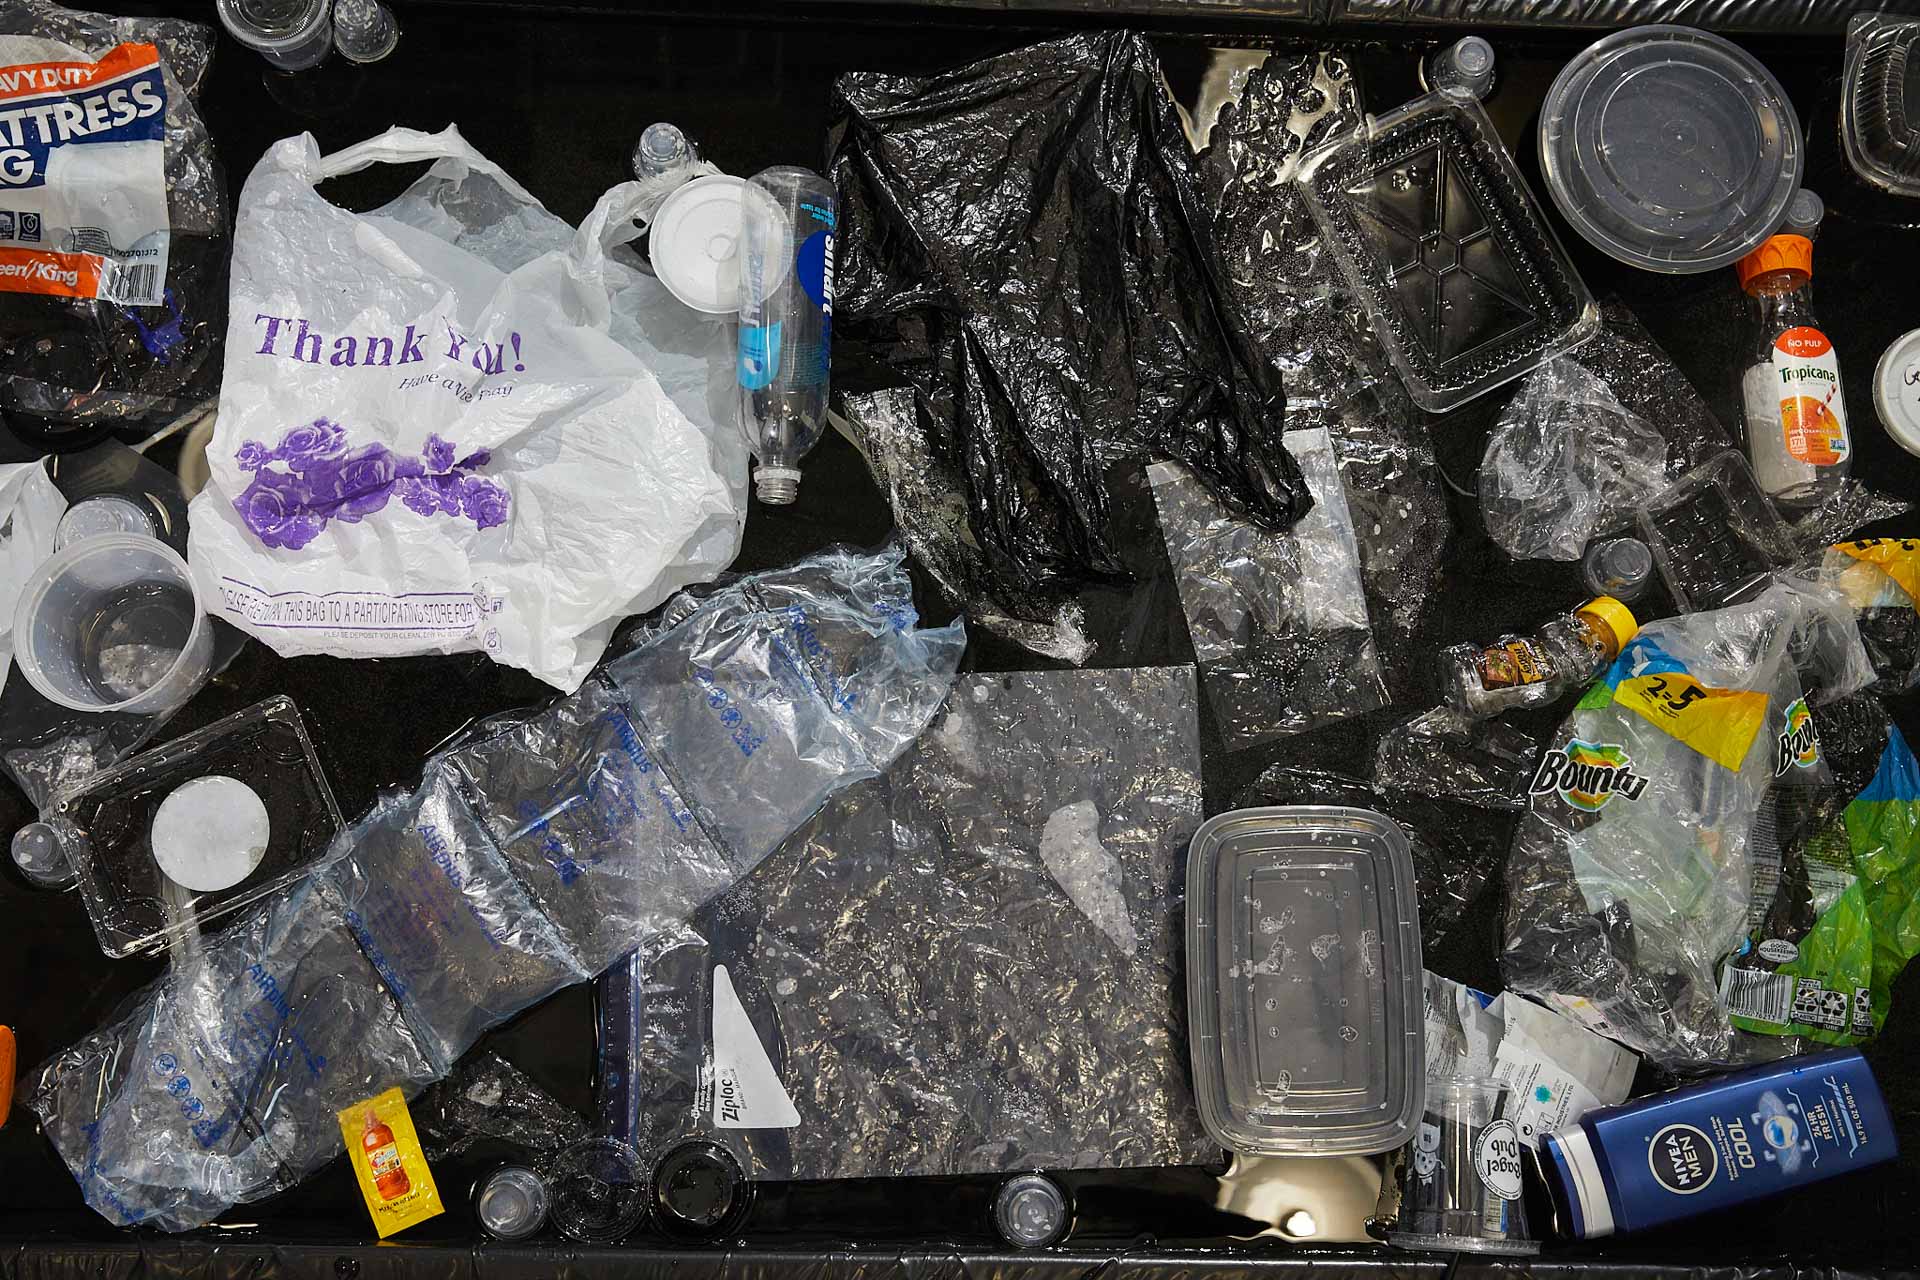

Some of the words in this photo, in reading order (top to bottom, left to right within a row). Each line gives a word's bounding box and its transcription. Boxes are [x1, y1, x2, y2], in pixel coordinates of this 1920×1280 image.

[254, 313, 429, 367] Thank
[1787, 339, 1802, 348] NO
[1804, 339, 1822, 348] PULP
[399, 371, 440, 390] Have
[1779, 364, 1836, 384] Tropicana
[285, 600, 304, 622] THIS
[306, 600, 327, 622] BAG
[328, 600, 342, 622] TO
[344, 601, 352, 622] A
[353, 601, 424, 624] PARTICIPATING
[425, 602, 454, 624] STORE
[1528, 750, 1650, 801] Bounty
[720, 1078, 741, 1122] Ziploc
[1806, 1111, 1817, 1124] HR
[1813, 1104, 1833, 1140] FRESH
[1727, 1117, 1756, 1169] COOL
[1812, 1125, 1823, 1138] 24
[1490, 1137, 1517, 1158] Pub
[1665, 1133, 1691, 1186] NIVEA
[1678, 1135, 1703, 1178] MEN
[1486, 1156, 1521, 1180] Bagel
